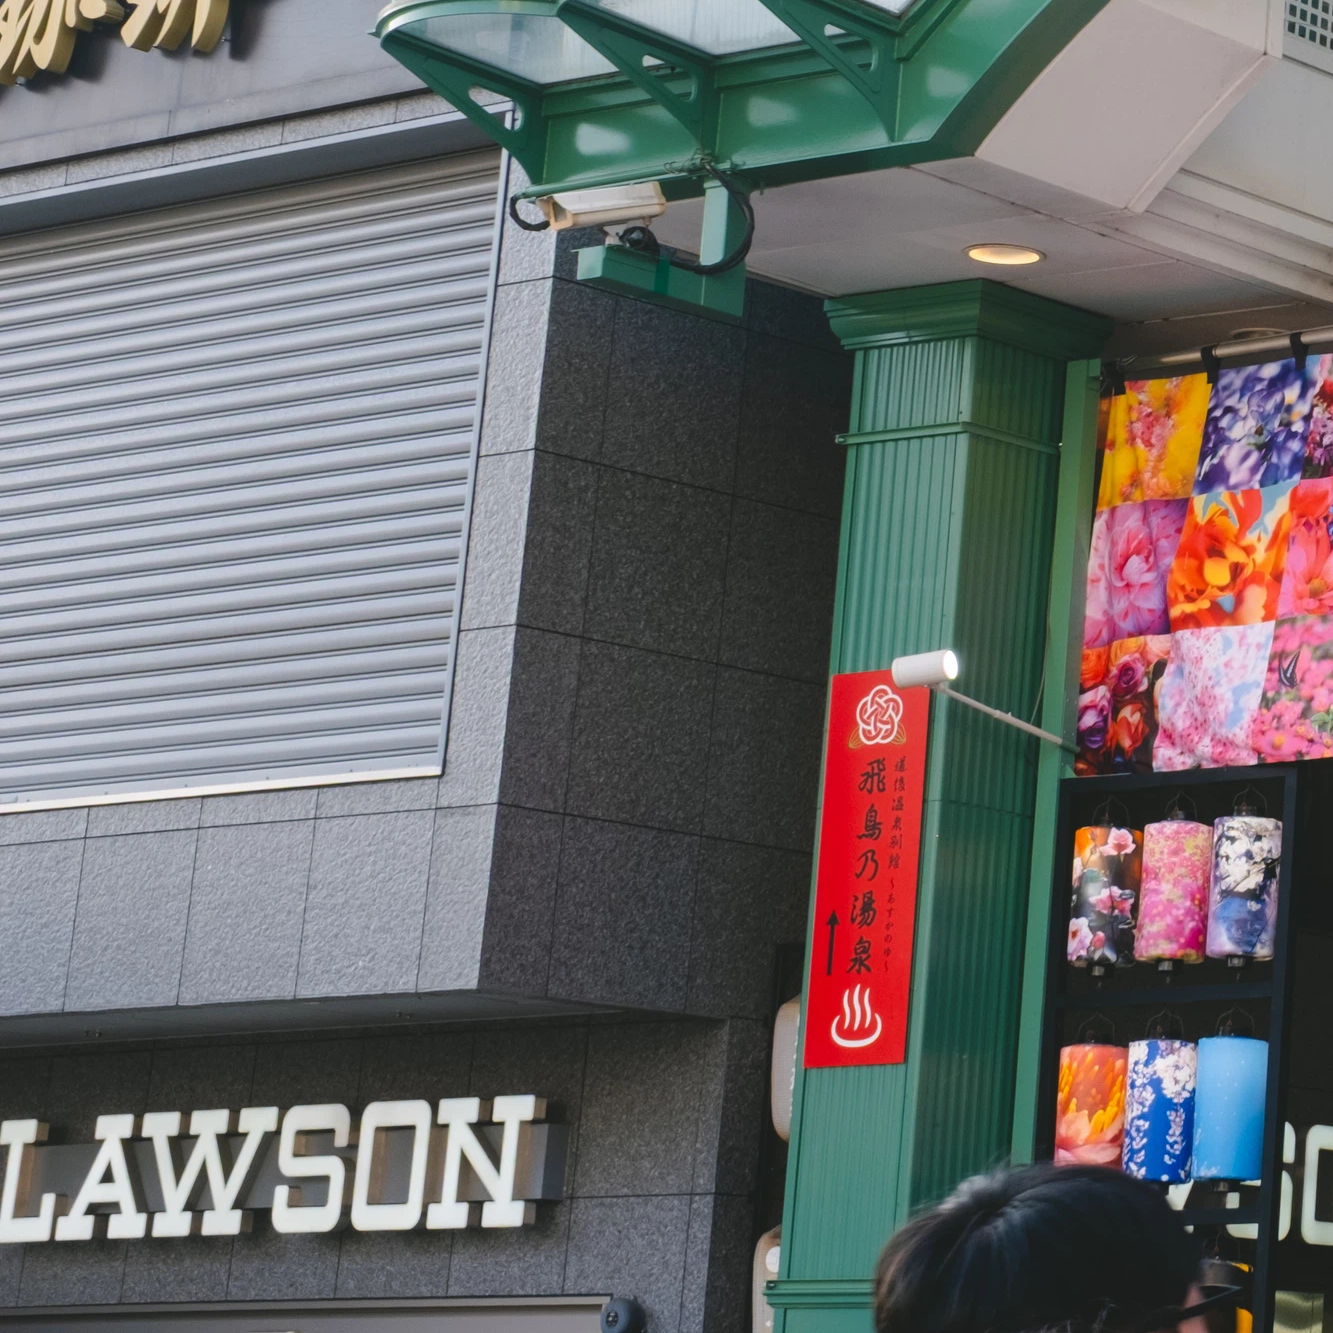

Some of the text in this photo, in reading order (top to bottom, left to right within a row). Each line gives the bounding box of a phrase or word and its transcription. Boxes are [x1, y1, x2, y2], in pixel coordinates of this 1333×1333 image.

[846, 756, 887, 976] 飛鳥乃湯泉
[0, 1094, 537, 1244] LAWSON
